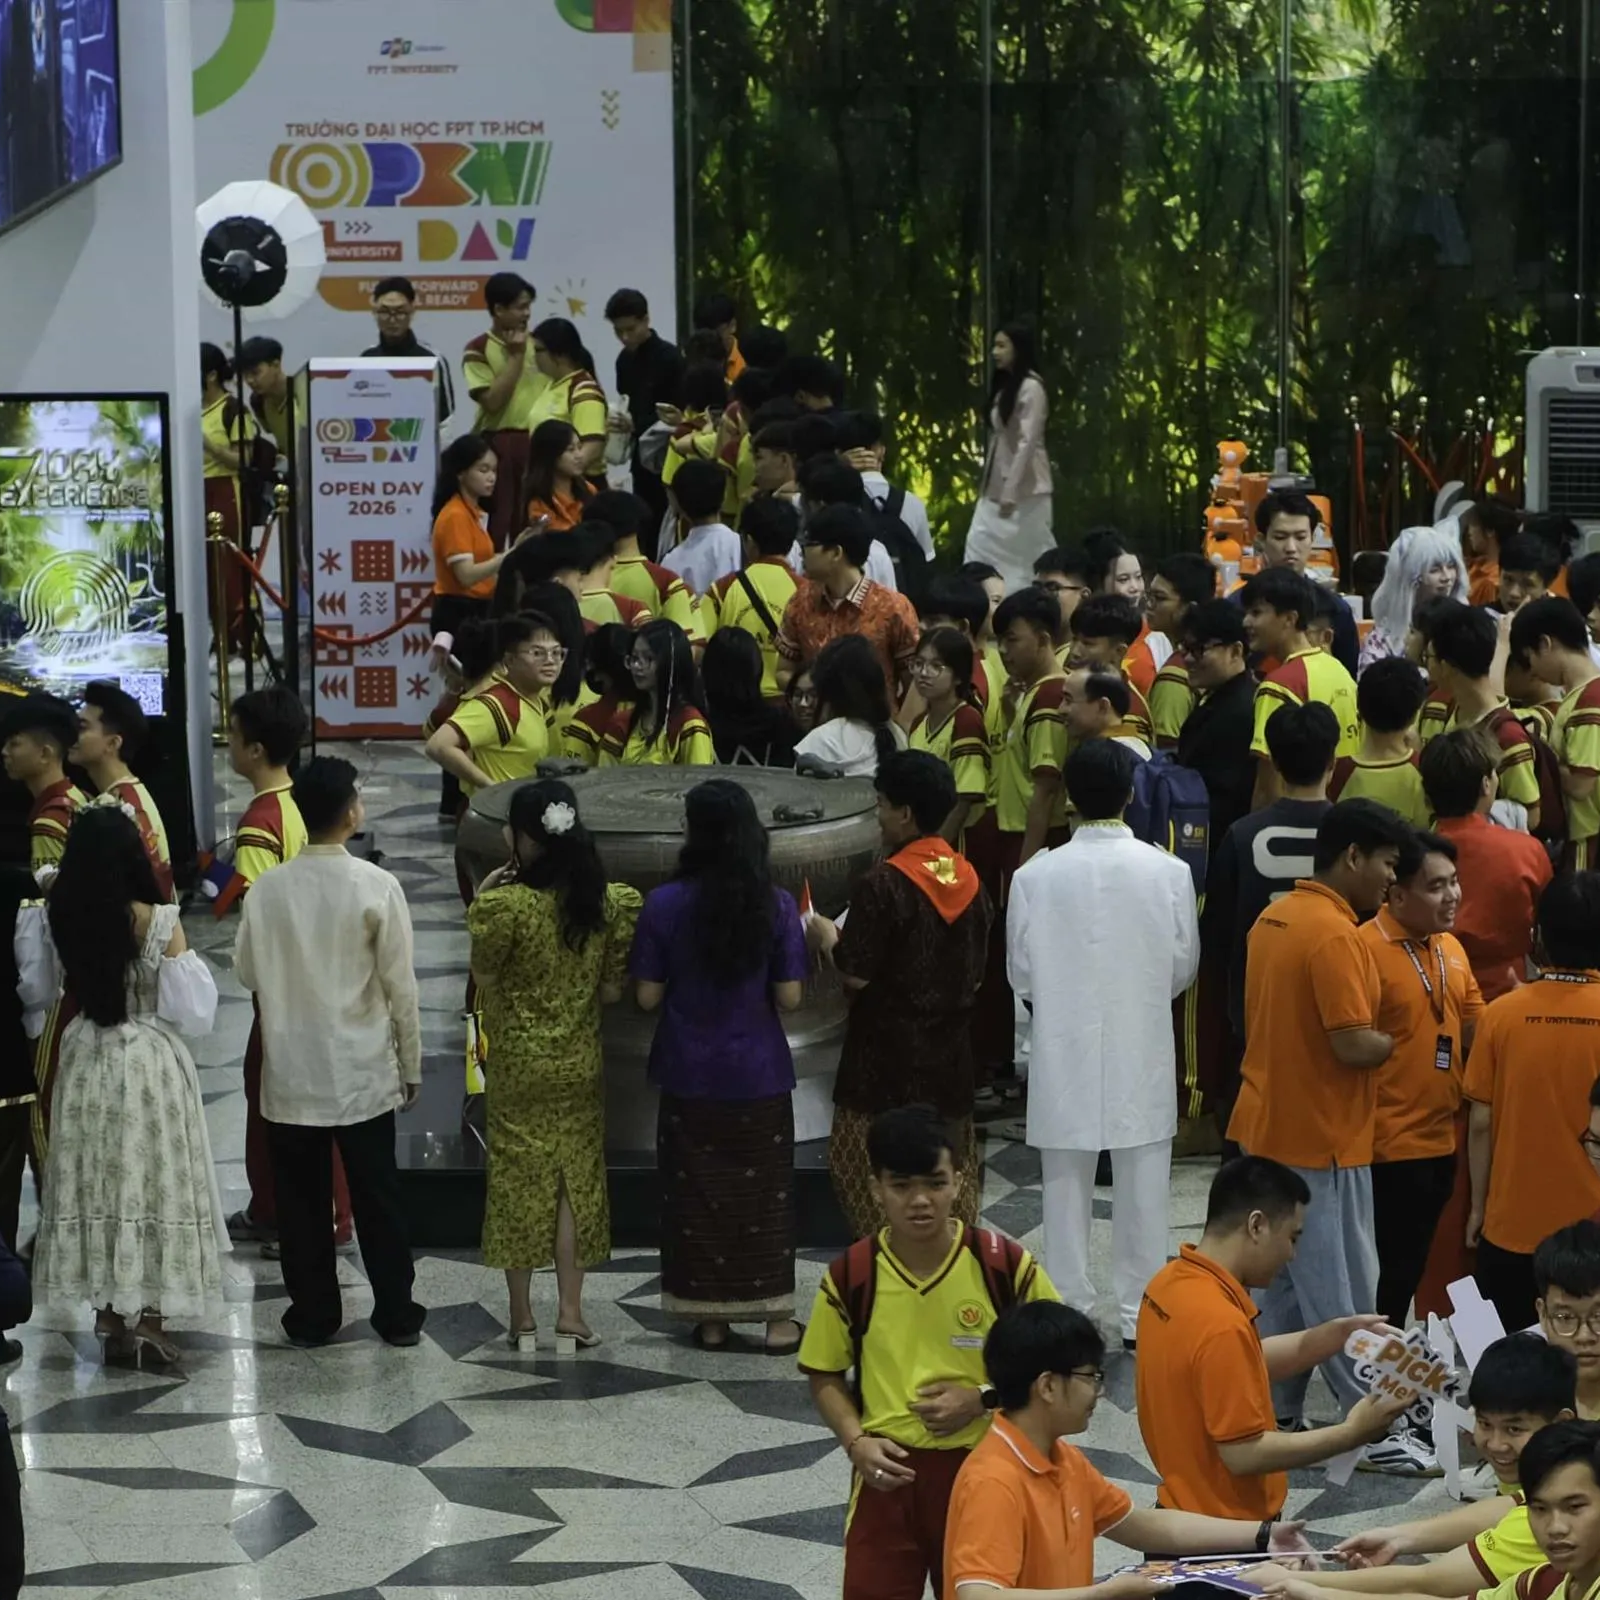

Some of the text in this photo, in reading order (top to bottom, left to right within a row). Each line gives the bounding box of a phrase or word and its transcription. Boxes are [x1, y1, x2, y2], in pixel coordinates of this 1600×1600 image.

[285, 119, 545, 141] TRƯỜNG ĐẠI HỌC FPT TP.HCM
[269, 141, 553, 209] OPEN
[418, 218, 536, 261] DAY
[319, 481, 424, 496] OPEN DAY
[348, 500, 397, 516] 2026
[1375, 1339, 1452, 1395] Pick
